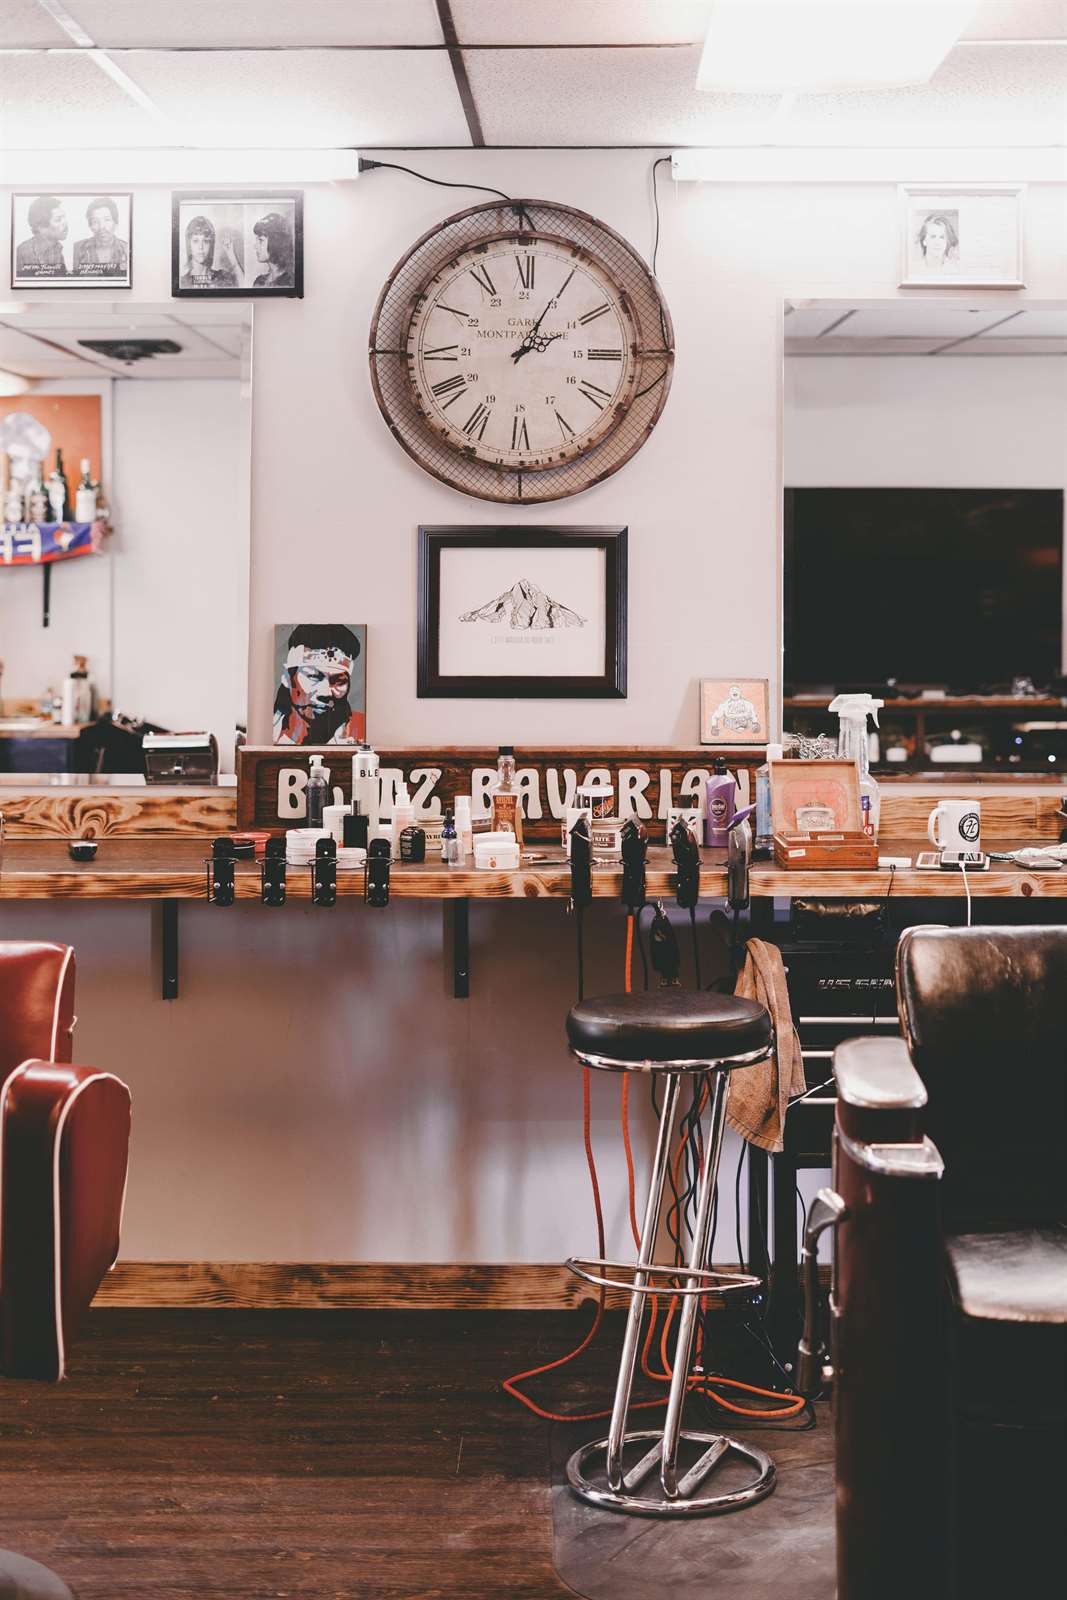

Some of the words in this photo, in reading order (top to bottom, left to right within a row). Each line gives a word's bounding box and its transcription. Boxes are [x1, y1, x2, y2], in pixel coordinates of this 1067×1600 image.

[490, 299, 501, 307] 23
[467, 319, 479, 327] 22
[461, 348, 471, 356] 21
[573, 351, 583, 359] 15
[588, 349, 621, 360] III
[467, 373, 478, 381] 20
[566, 376, 576, 384] 16
[486, 395, 496, 403] 19
[545, 396, 555, 405] 17
[515, 404, 525, 412] 18
